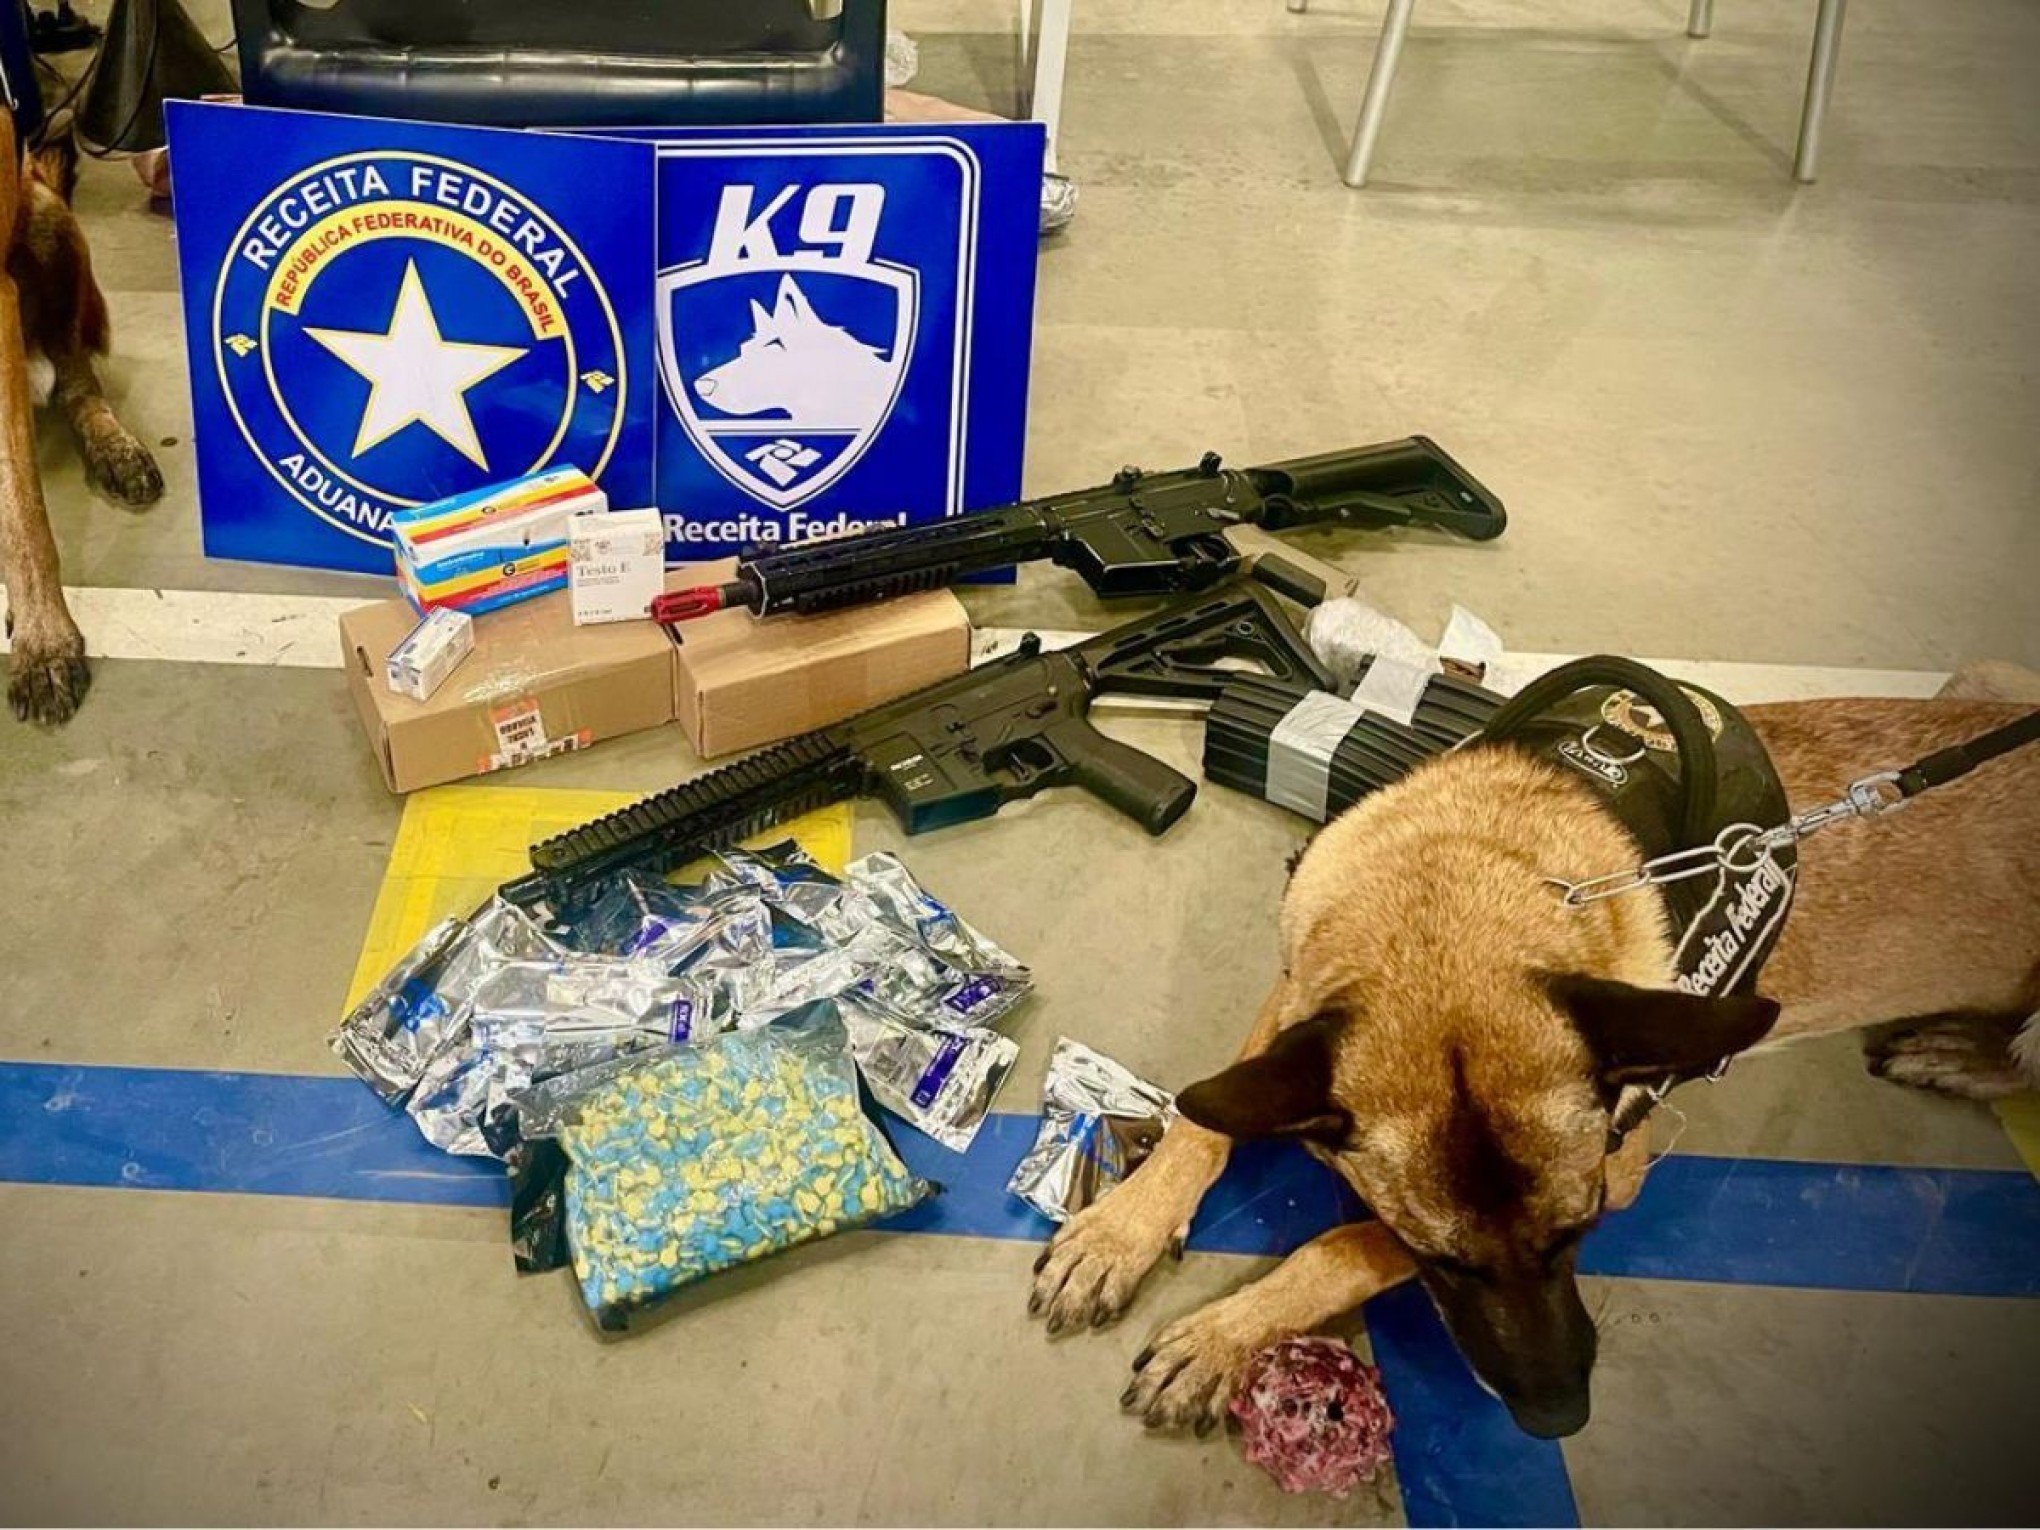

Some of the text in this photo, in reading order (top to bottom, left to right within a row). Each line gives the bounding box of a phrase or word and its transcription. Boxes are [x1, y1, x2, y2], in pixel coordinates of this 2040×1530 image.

[243, 165, 582, 299] RECEITA FEDERAL
[707, 183, 886, 264] K9
[276, 211, 556, 333] REPÚBLICA FEDERATIVA DO BRASIL
[279, 453, 398, 532] ADUANA
[662, 512, 781, 542] Receita
[1725, 853, 1782, 943] Federal
